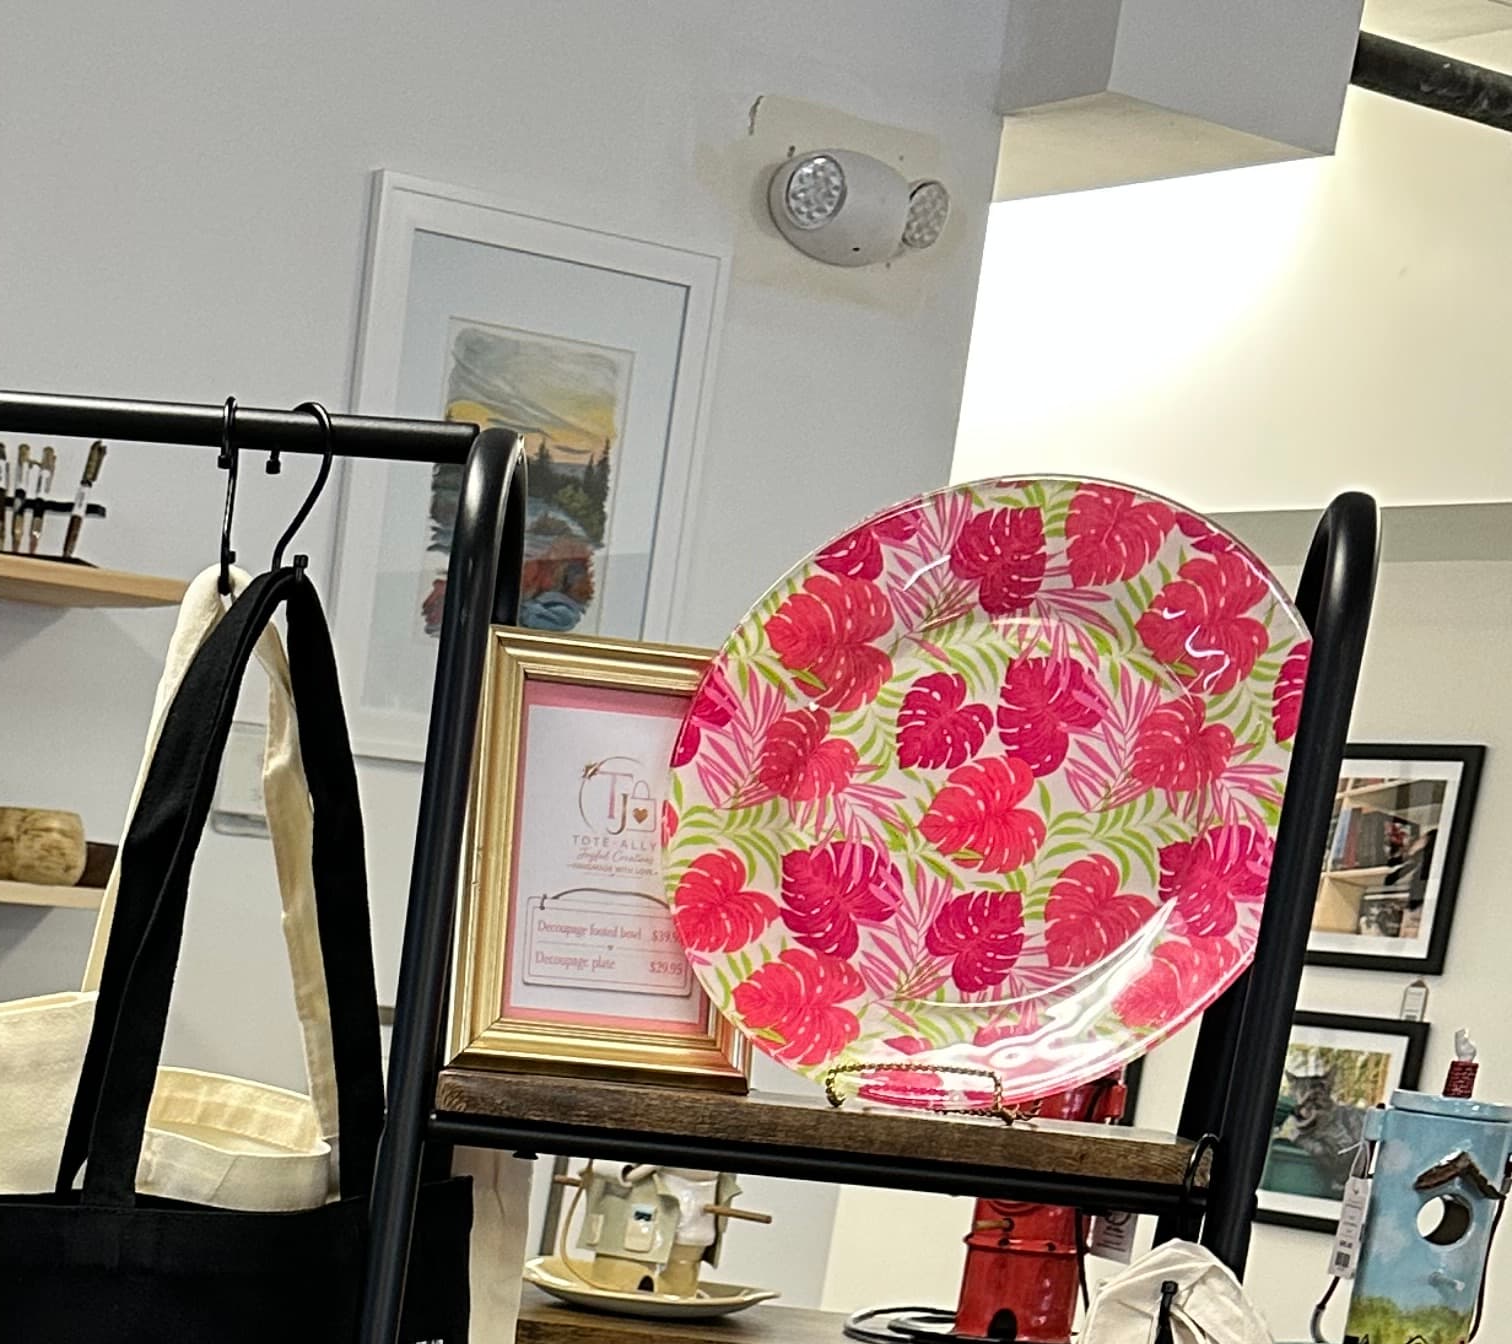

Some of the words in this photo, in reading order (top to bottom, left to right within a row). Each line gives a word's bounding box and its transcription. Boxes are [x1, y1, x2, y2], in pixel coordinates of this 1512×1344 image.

[538, 919, 587, 937] Decoupage
[620, 926, 642, 940] bowl
[536, 951, 588, 970] Decoupage
[591, 955, 616, 973] plate
